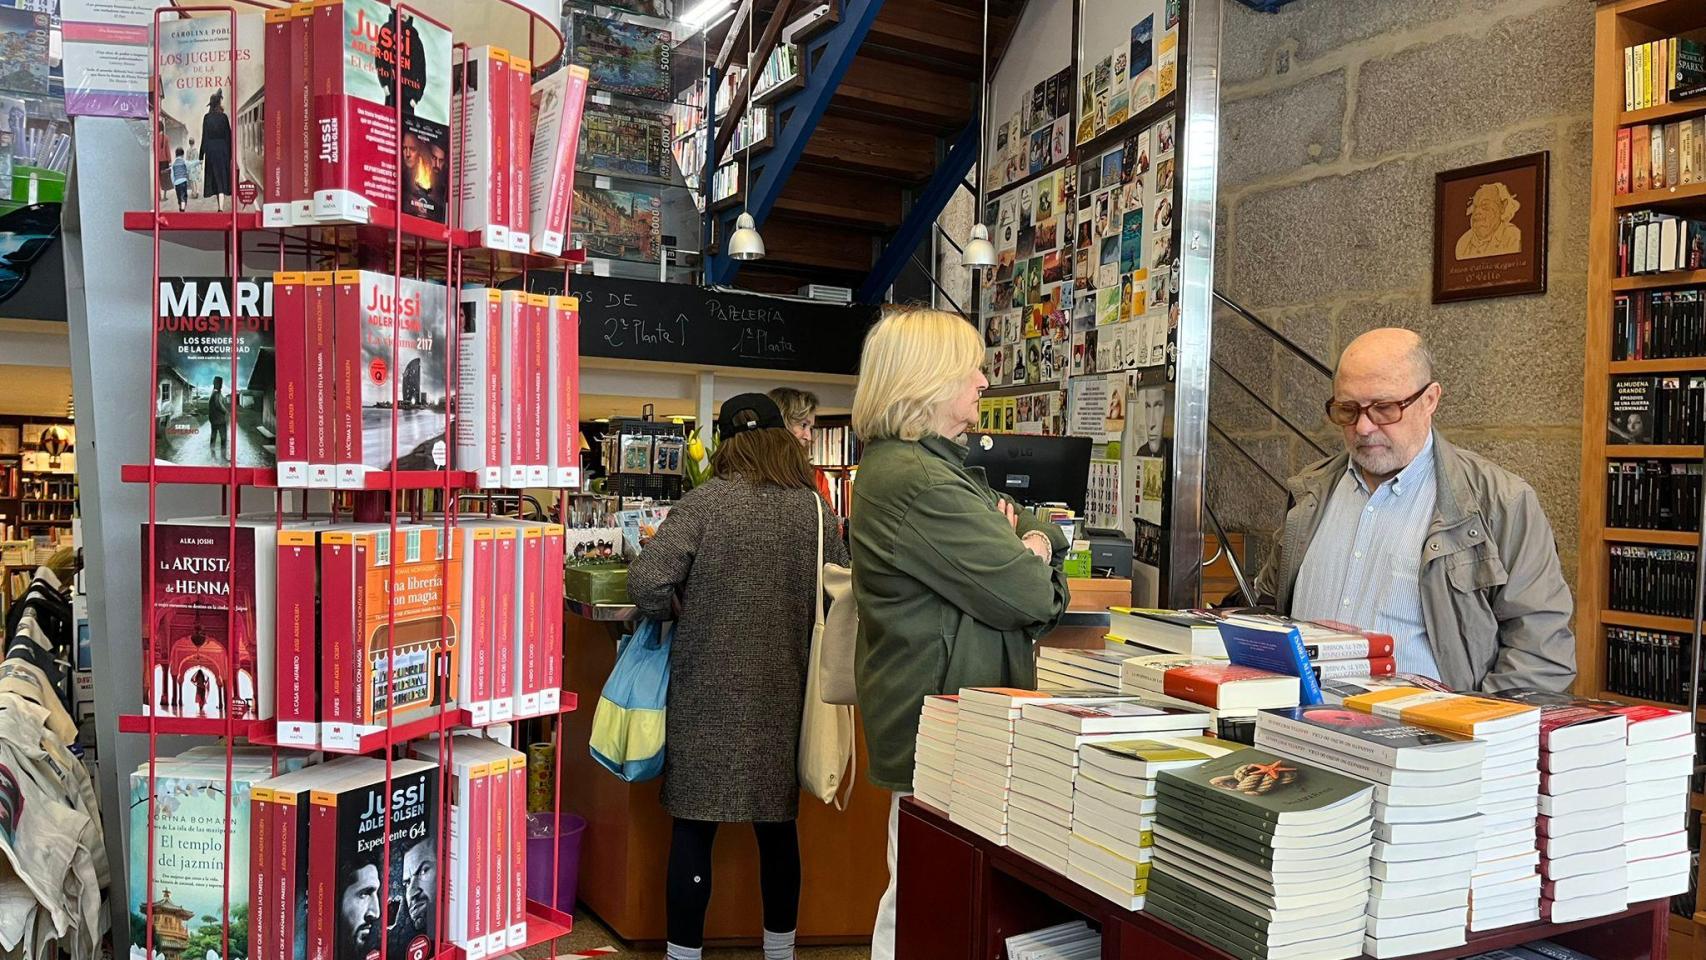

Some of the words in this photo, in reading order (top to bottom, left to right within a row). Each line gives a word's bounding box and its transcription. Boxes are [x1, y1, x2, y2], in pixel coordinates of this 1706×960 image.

[171, 28, 208, 39] CAROLINA
[211, 28, 232, 36] POBL
[160, 53, 183, 66] LOS
[184, 49, 251, 66] JUGUETES
[351, 39, 411, 70] ADLER-OLEN
[660, 44, 670, 71] 5000
[193, 66, 203, 74] DE
[1678, 59, 1704, 72] SPARKS
[176, 77, 233, 90] GUERRA
[303, 121, 309, 131] EN
[318, 118, 332, 163] Jussi
[331, 117, 339, 163] ADLER-OLSEN
[660, 127, 670, 155] 5000
[159, 281, 274, 317] MARI
[367, 283, 421, 317] Jussi
[605, 293, 638, 308] DE
[157, 316, 273, 333] JUNGSTEDT
[633, 319, 674, 344] Planta
[183, 336, 200, 345] LOS
[416, 336, 433, 352] 2117
[755, 329, 796, 353] Planta
[177, 345, 190, 354] DE
[190, 345, 202, 354] LA
[318, 380, 325, 388] EN
[345, 451, 352, 459] LA
[1020, 448, 1033, 457] LG
[1092, 463, 1096, 474] 2
[1100, 463, 1104, 475] 3
[1106, 464, 1111, 475] 4
[1113, 465, 1118, 476] 5
[1098, 476, 1105, 488] 10
[1106, 477, 1112, 489] 11
[1112, 478, 1119, 489] 12
[1090, 488, 1097, 499] 16
[1097, 488, 1104, 500] 17
[1105, 489, 1111, 501] 18
[1112, 490, 1118, 502] 19
[1097, 501, 1104, 513] 24
[1104, 502, 1111, 514] 25
[1111, 503, 1118, 515] 26
[179, 537, 196, 545] ALKA
[196, 537, 214, 546] JOSHI
[160, 560, 170, 570] La
[165, 583, 174, 593] de
[175, 579, 230, 596] HENNA
[407, 574, 443, 590] librería
[407, 587, 438, 606] magia
[293, 707, 300, 715] LA
[360, 775, 426, 820] Jussi
[147, 814, 186, 822] ORINA
[358, 802, 425, 834] ADLE-OLSEN
[176, 824, 187, 832] isla
[196, 825, 205, 833] las
[357, 830, 407, 852] Expedente
[408, 820, 426, 840] 64
[161, 834, 173, 848] El
[178, 837, 222, 854] templo
[158, 853, 176, 867] del
[180, 855, 224, 871] jazmín
